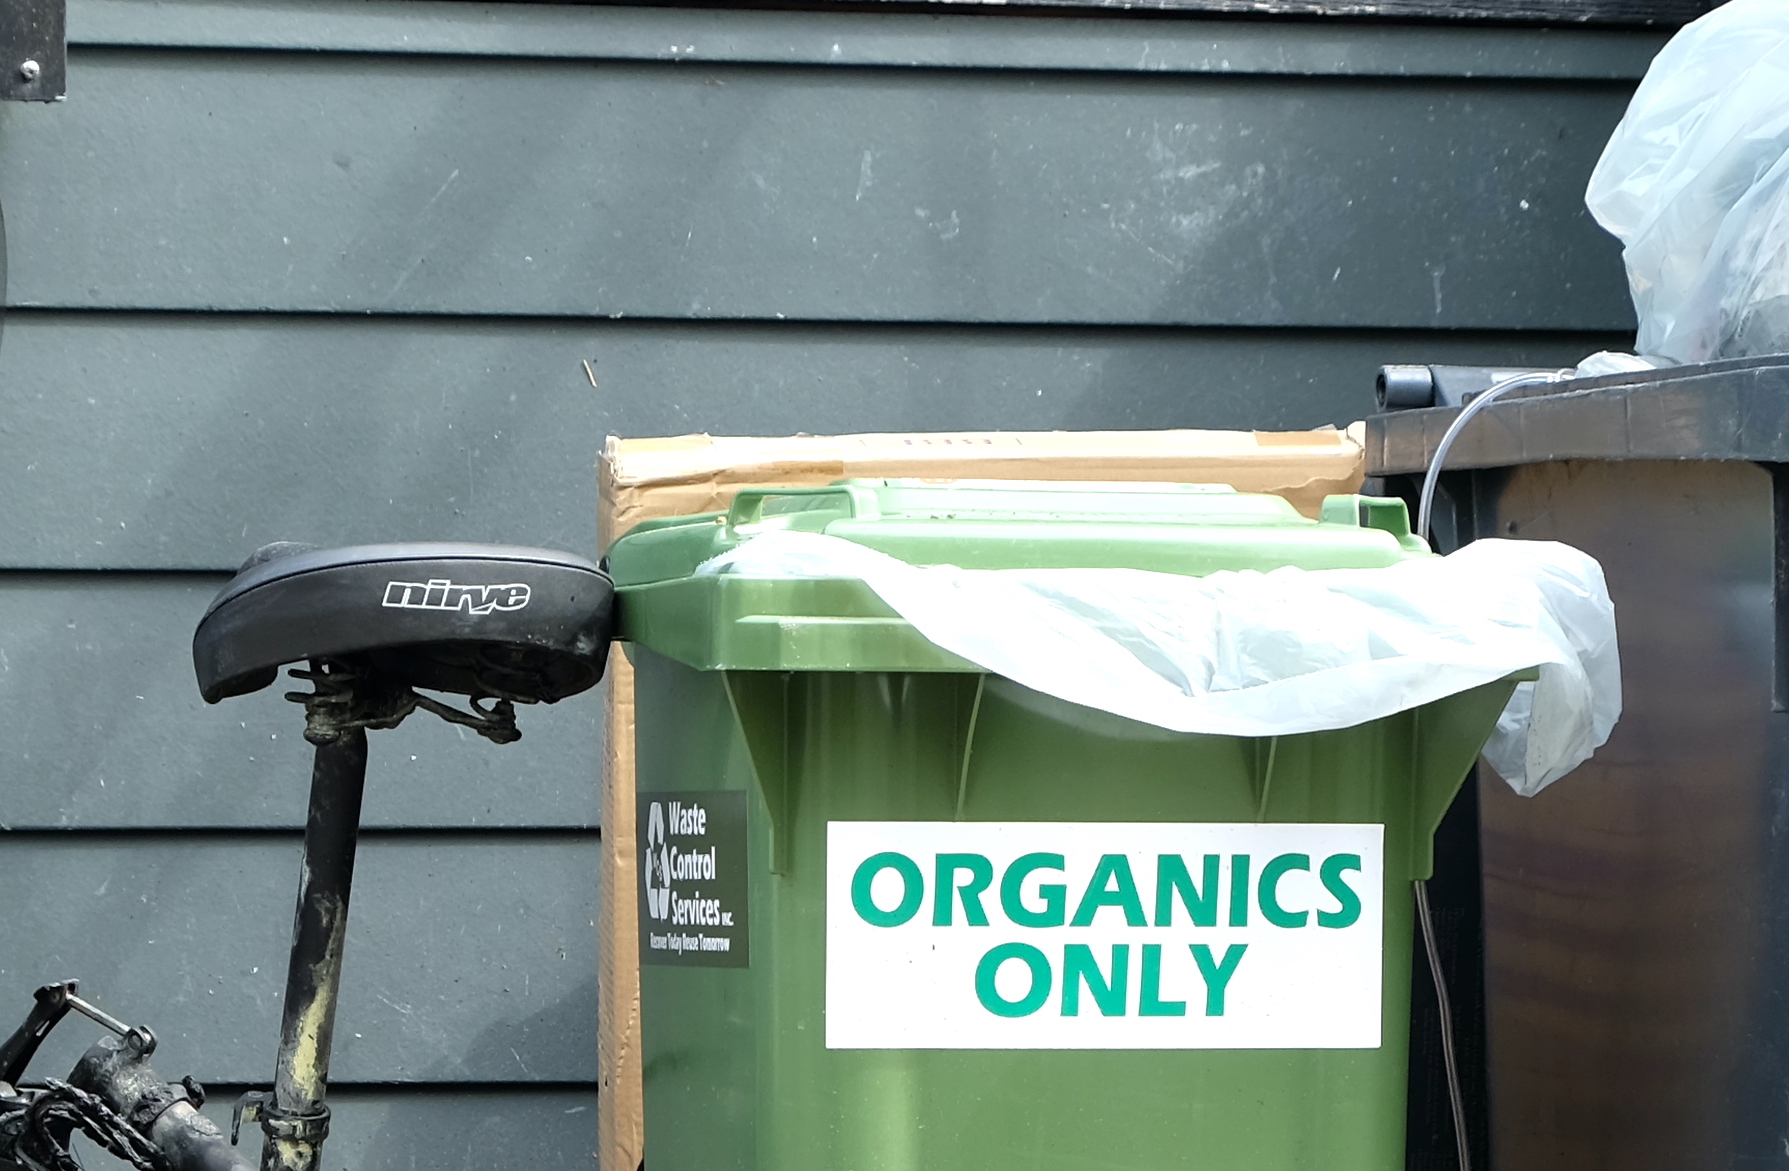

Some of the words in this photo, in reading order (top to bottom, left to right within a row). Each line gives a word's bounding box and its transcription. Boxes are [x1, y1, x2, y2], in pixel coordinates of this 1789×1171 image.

[668, 800, 706, 836] Waste
[669, 845, 716, 881] Control
[670, 890, 721, 926] Services
[851, 851, 1362, 929] ORGANICS
[975, 942, 1248, 1018] ONLY
